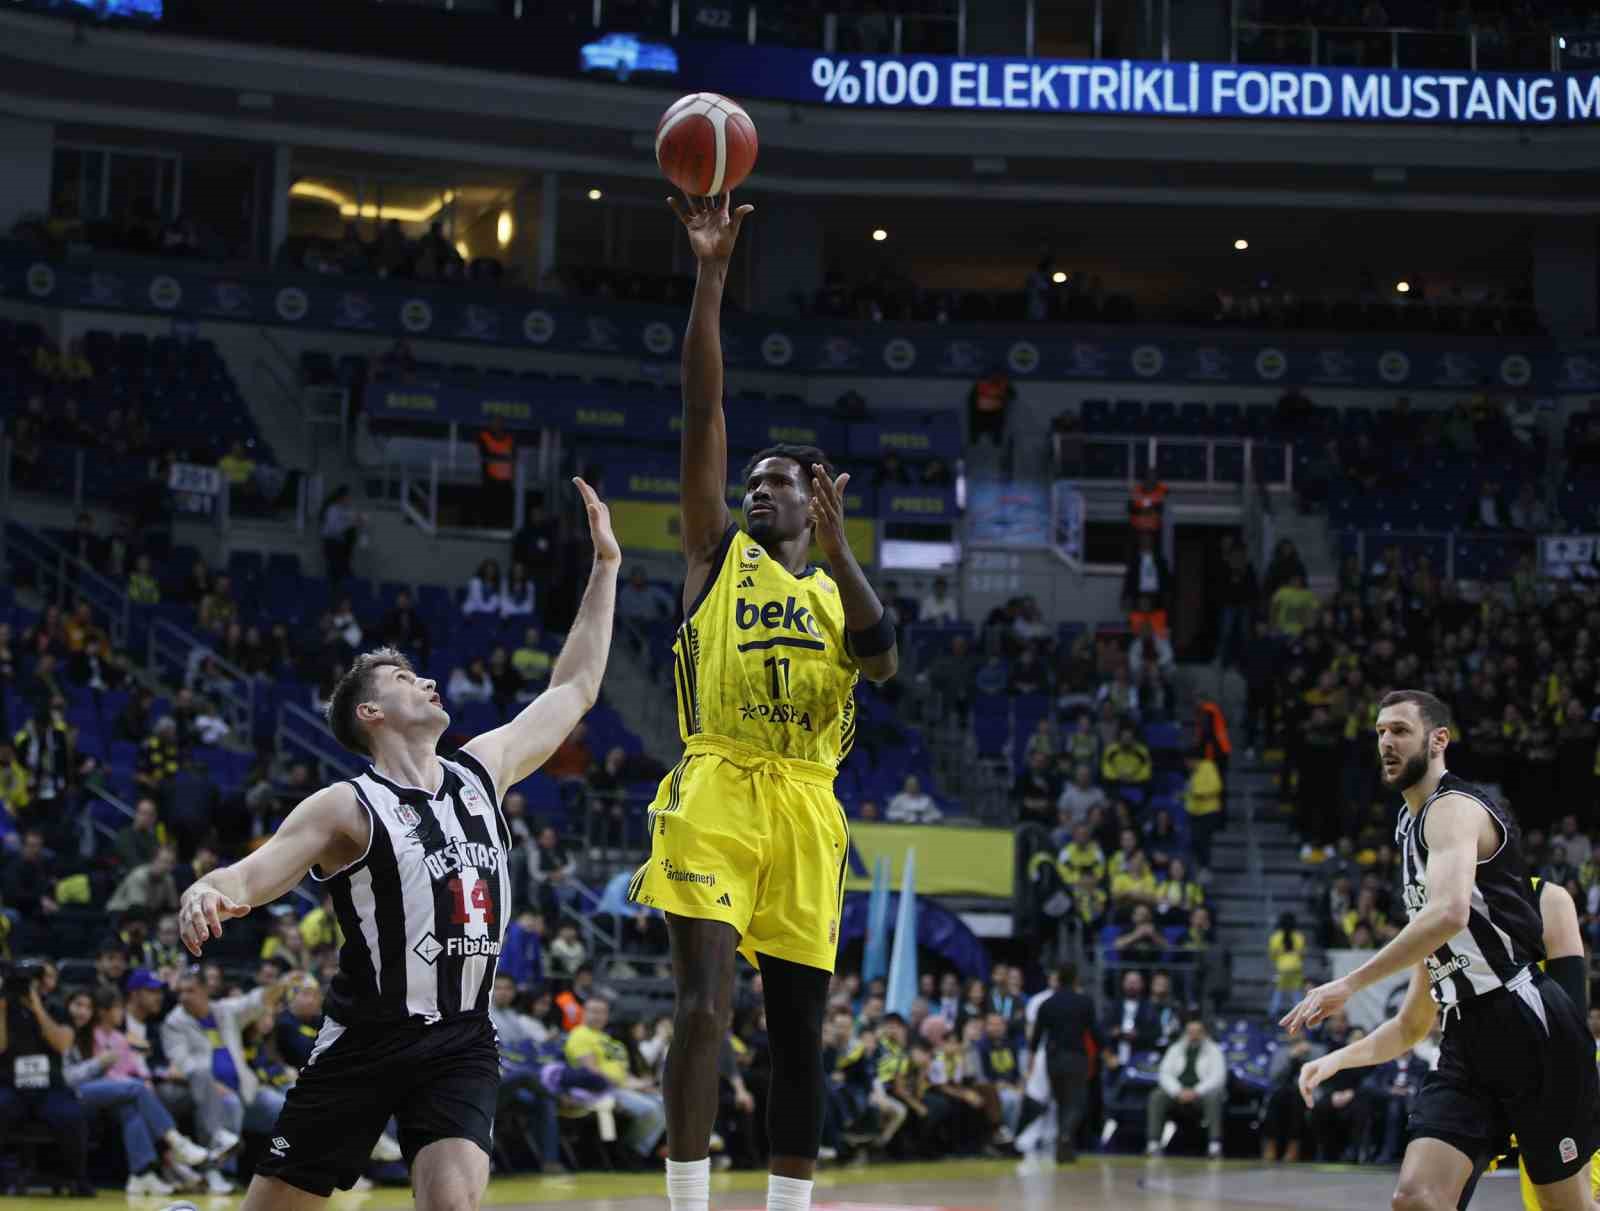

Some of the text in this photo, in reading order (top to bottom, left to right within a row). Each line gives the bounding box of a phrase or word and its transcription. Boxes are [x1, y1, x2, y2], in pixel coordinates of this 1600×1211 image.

[812, 57, 939, 105] %100
[951, 60, 1199, 113] ELEKTRİKLİ
[1211, 69, 1333, 117] FORD
[1341, 72, 1557, 121] MUSTANG
[764, 656, 791, 699] 11
[447, 877, 497, 925] 14
